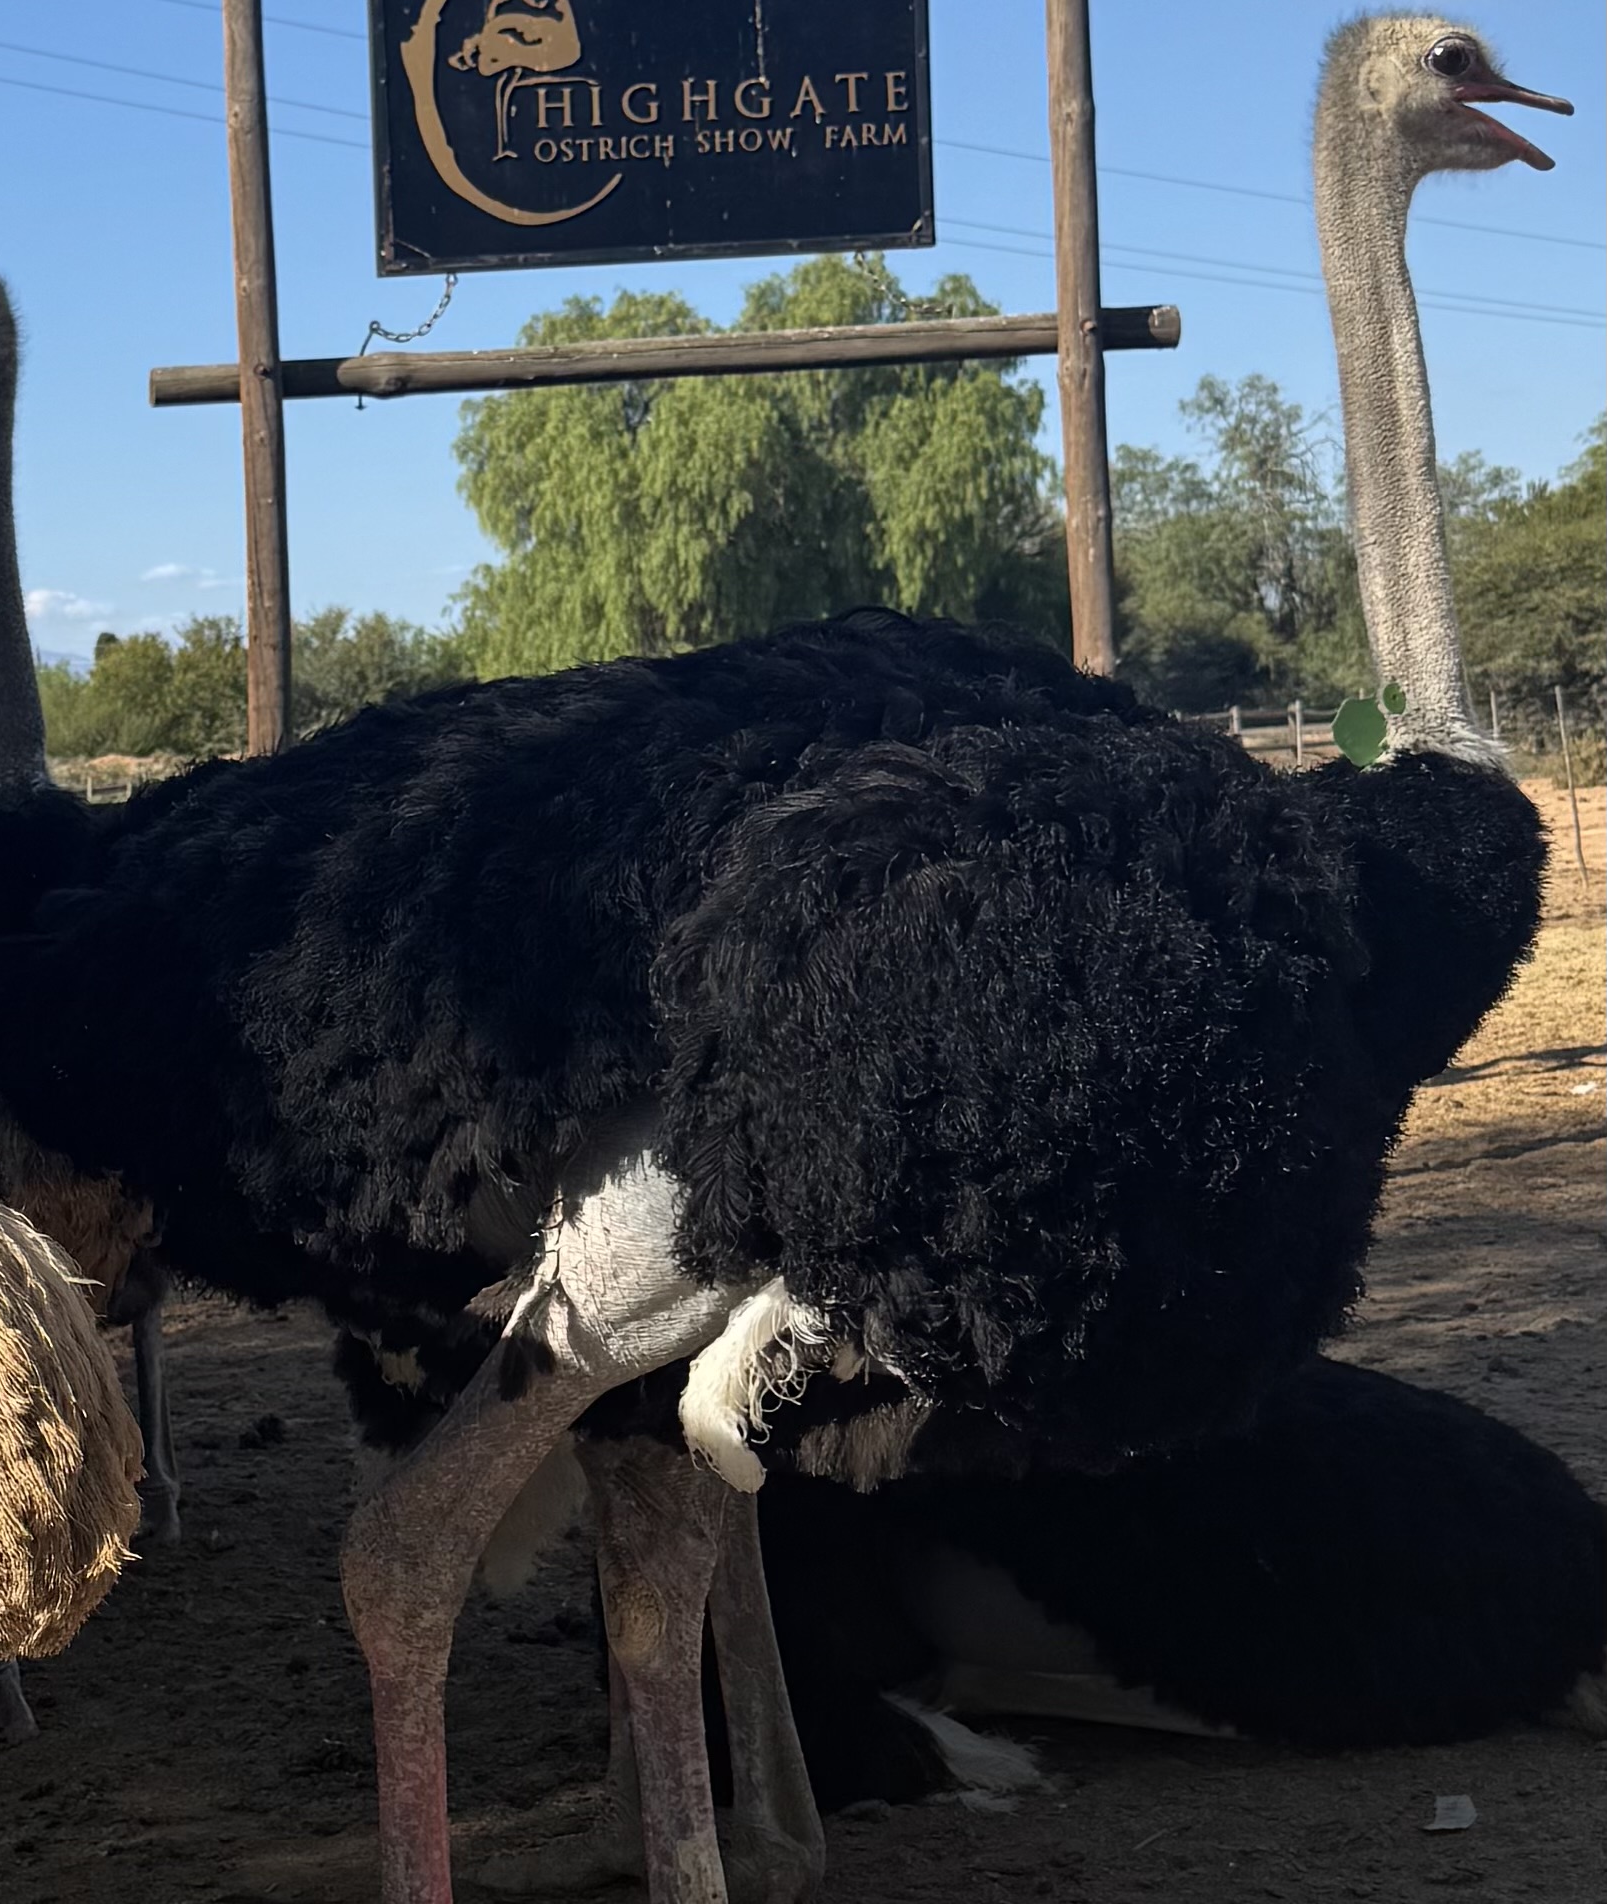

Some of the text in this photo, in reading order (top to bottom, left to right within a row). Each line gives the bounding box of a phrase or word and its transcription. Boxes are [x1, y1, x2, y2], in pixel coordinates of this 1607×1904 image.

[536, 71, 910, 129] HIGHGATE
[533, 122, 908, 163] OSTRICH SHOW FARM
